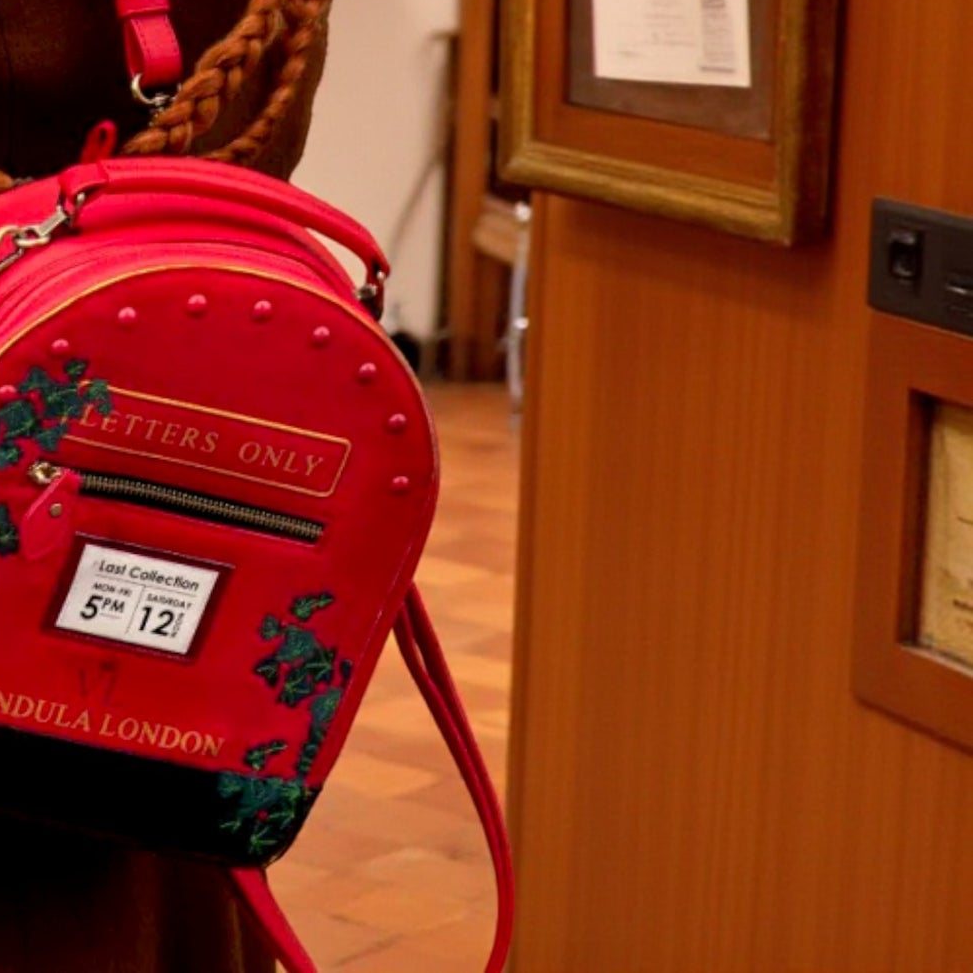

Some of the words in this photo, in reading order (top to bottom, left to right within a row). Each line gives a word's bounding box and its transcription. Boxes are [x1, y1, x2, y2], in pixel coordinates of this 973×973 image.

[79, 403, 219, 453] LETTERS
[238, 441, 324, 477] ONLY
[99, 560, 126, 576] Last
[129, 566, 199, 592] Collection
[146, 592, 193, 610] SATURDAY
[138, 606, 174, 636] 12
[98, 713, 225, 757] LONDON
